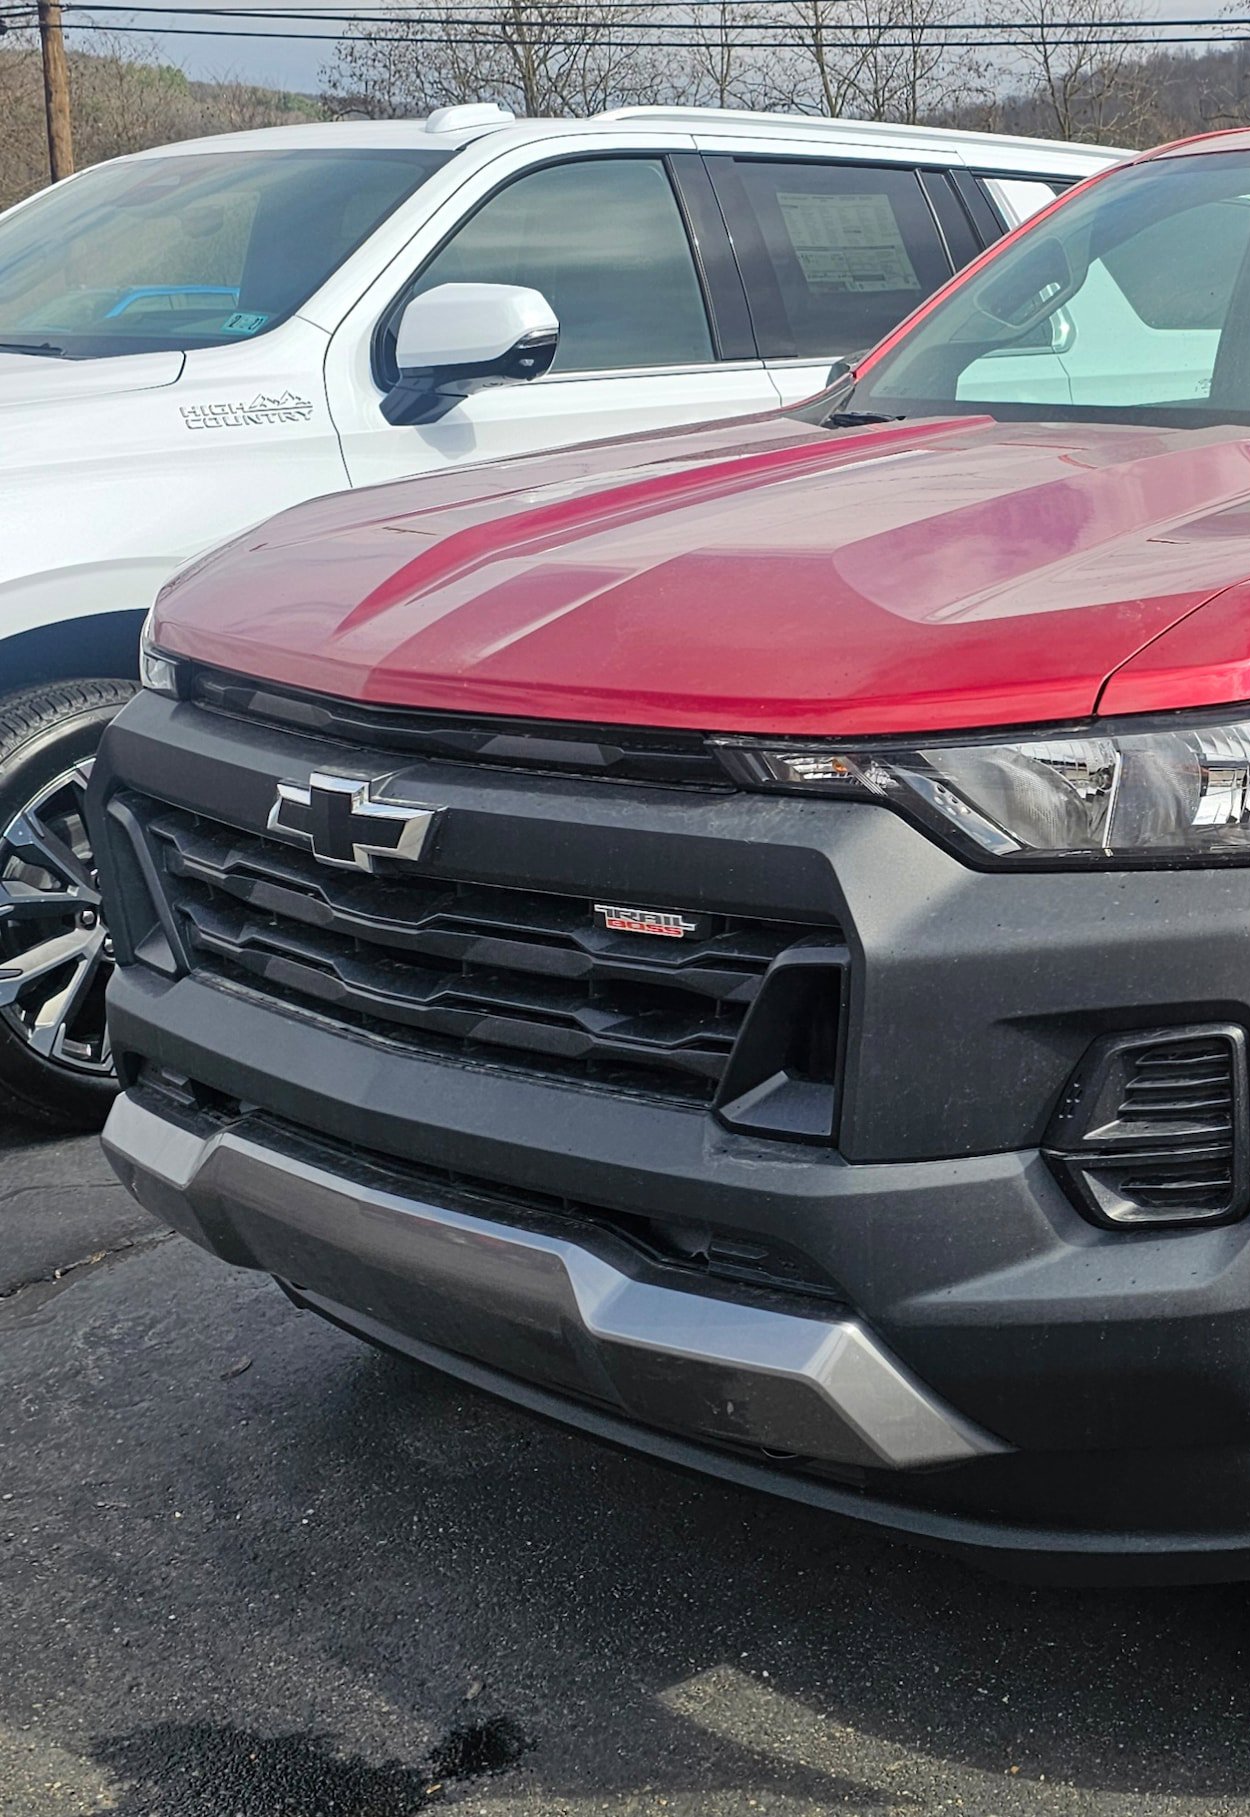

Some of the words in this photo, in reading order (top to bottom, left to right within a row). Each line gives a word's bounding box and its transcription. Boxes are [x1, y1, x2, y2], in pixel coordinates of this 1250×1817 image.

[179, 402, 246, 418] HIGH
[185, 409, 313, 430] COUNTRY
[594, 903, 697, 931] TRAIL
[605, 918, 684, 938] BOSS
